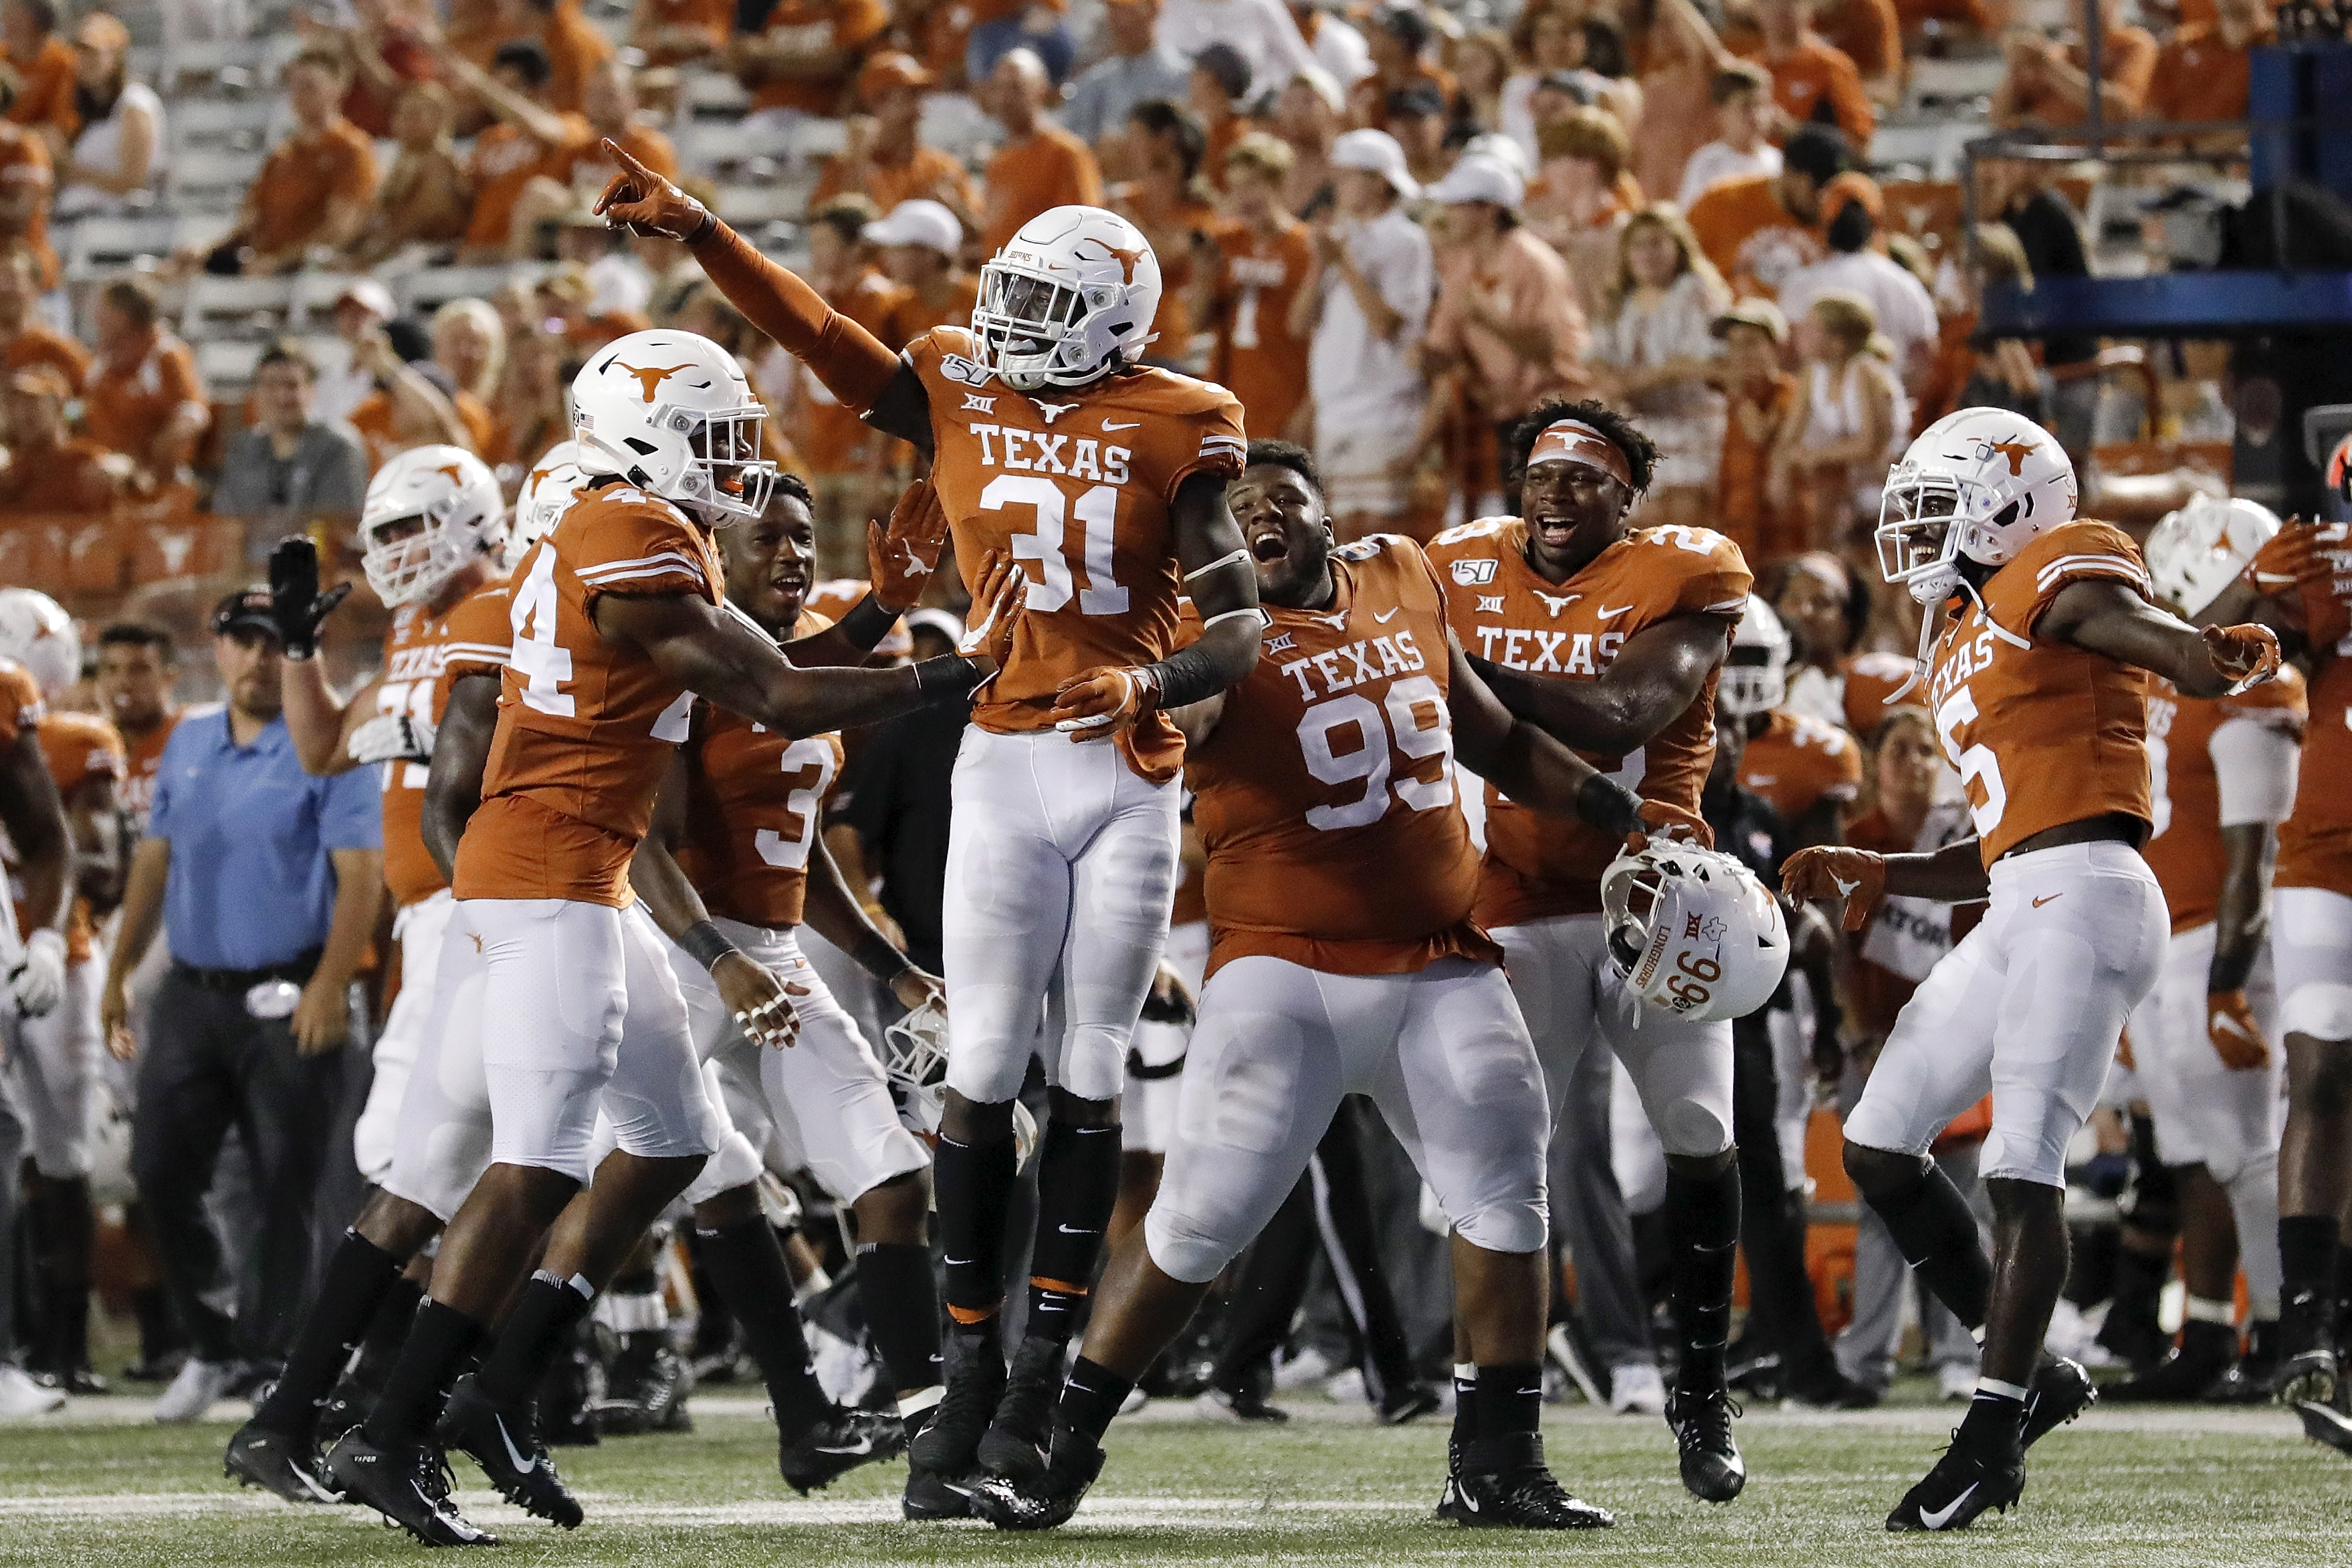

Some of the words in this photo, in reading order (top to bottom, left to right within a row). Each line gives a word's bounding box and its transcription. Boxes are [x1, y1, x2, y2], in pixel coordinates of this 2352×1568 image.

[961, 393, 998, 421] XII
[970, 423, 1132, 484] TEXAS
[979, 474, 1130, 616] 31
[1449, 558, 1499, 586] 150
[510, 542, 576, 718] 4
[1475, 594, 1505, 614] XII
[1263, 631, 1298, 655] XII
[1280, 630, 1426, 703] TEXAS
[1476, 625, 1625, 675] TEXAS
[1296, 675, 1455, 831] 99
[1936, 683, 2006, 838] 5
[754, 738, 835, 869] 3
[1682, 910, 1703, 942] XII
[1635, 925, 1672, 990] LONGHORNS
[1667, 950, 1721, 1004] 99
